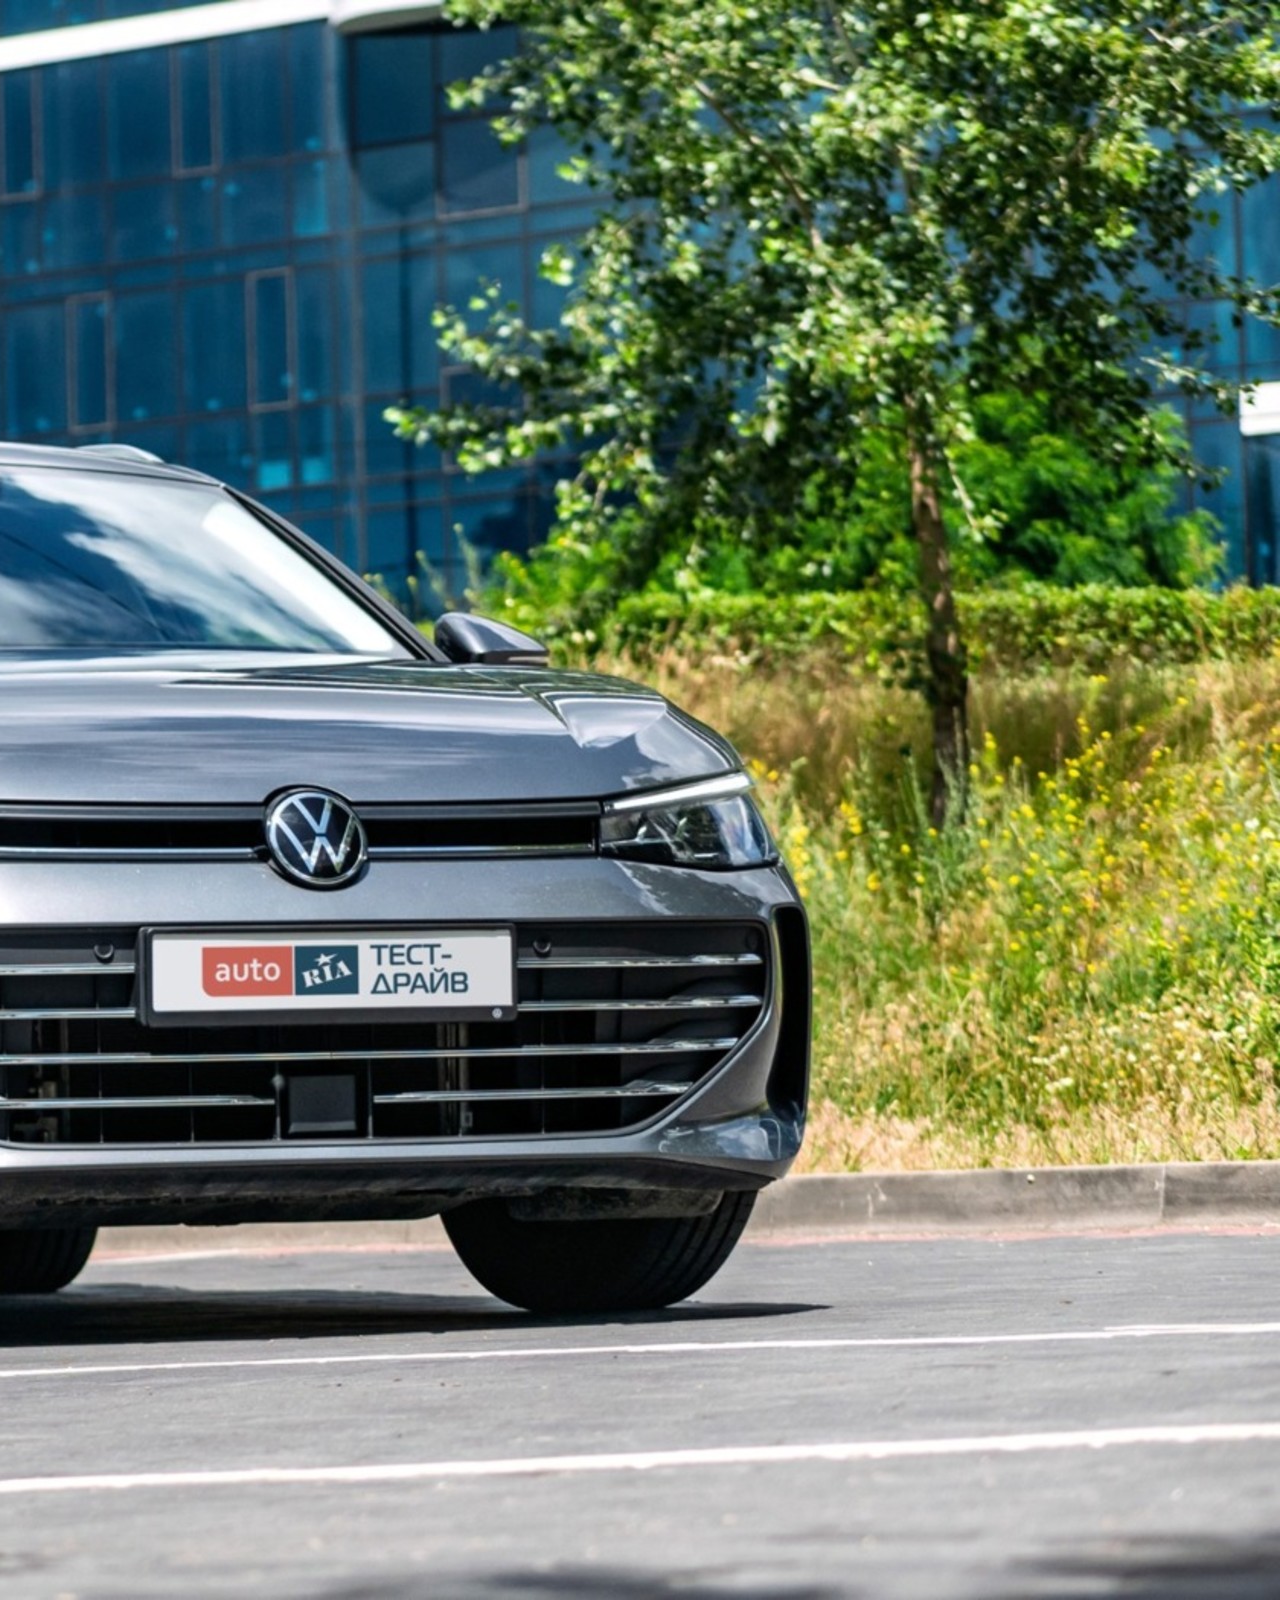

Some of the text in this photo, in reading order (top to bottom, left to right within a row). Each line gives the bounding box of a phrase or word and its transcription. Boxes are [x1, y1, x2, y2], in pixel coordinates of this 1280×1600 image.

[272, 793, 361, 882] VW
[370, 943, 452, 966] ТЕСТ-
[214, 957, 353, 988] auto RIA
[370, 967, 469, 994] ДРАЙВ
